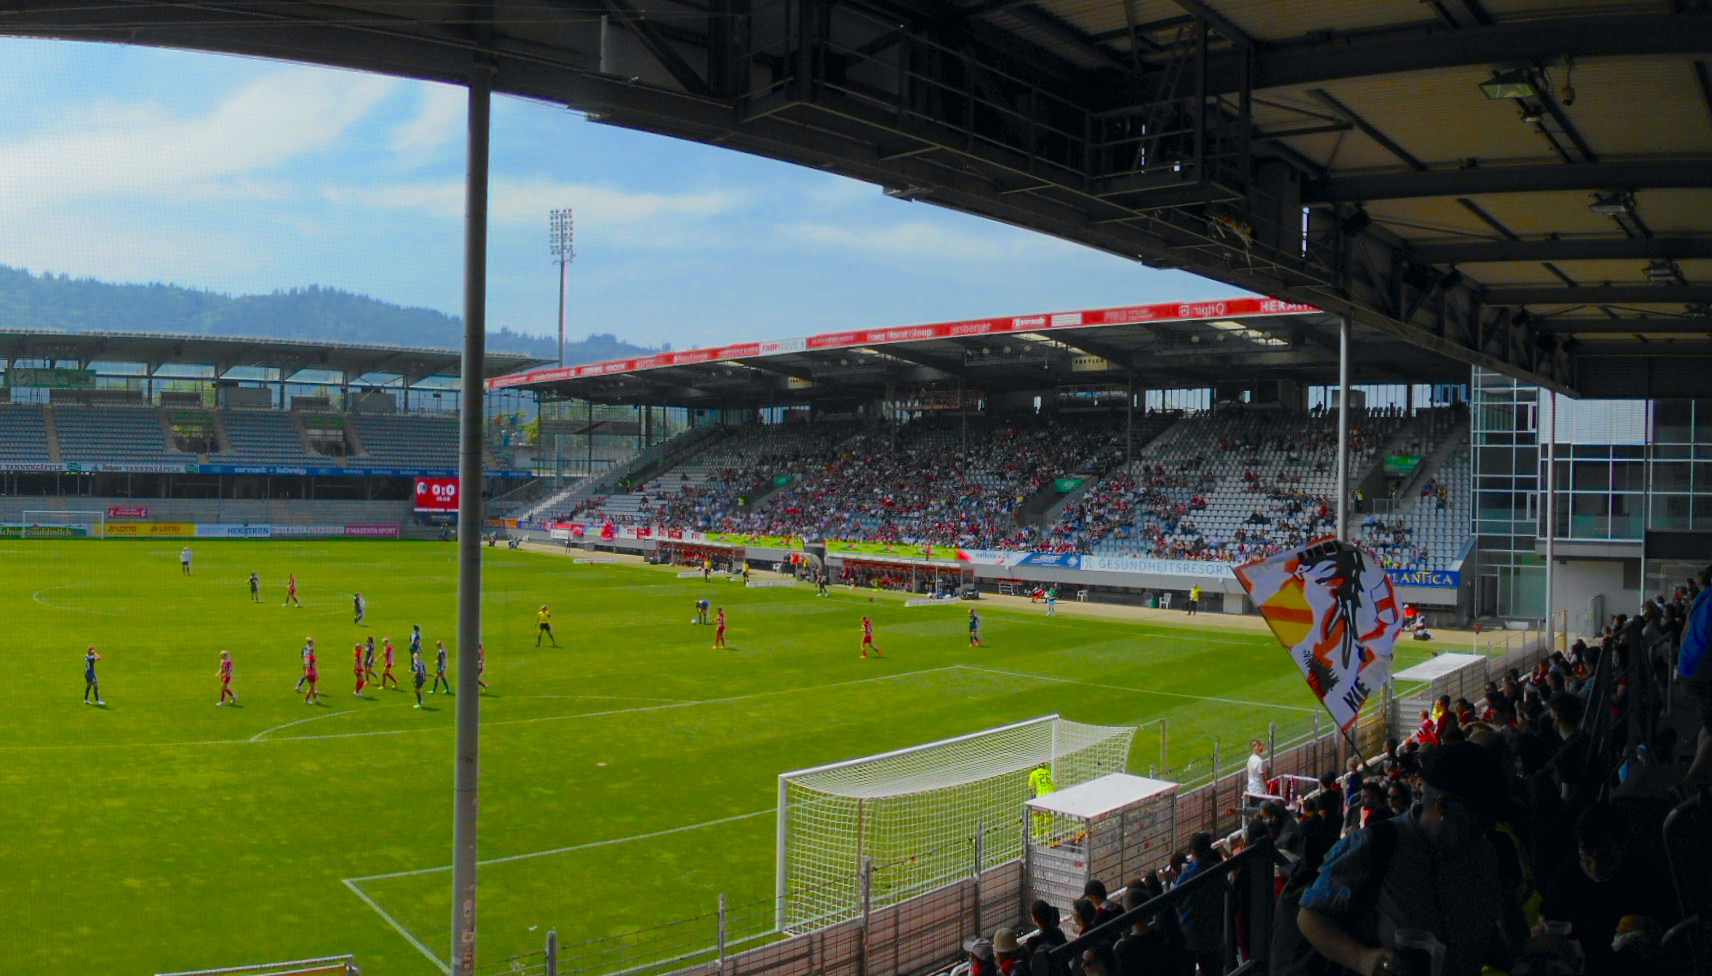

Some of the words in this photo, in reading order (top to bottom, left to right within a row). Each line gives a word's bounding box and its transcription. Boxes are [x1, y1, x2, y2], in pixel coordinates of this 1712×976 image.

[431, 484, 456, 496] 0:0
[1098, 557, 1231, 577] GESUNDHEITSRESORT
[1390, 569, 1454, 585] LANTICA
